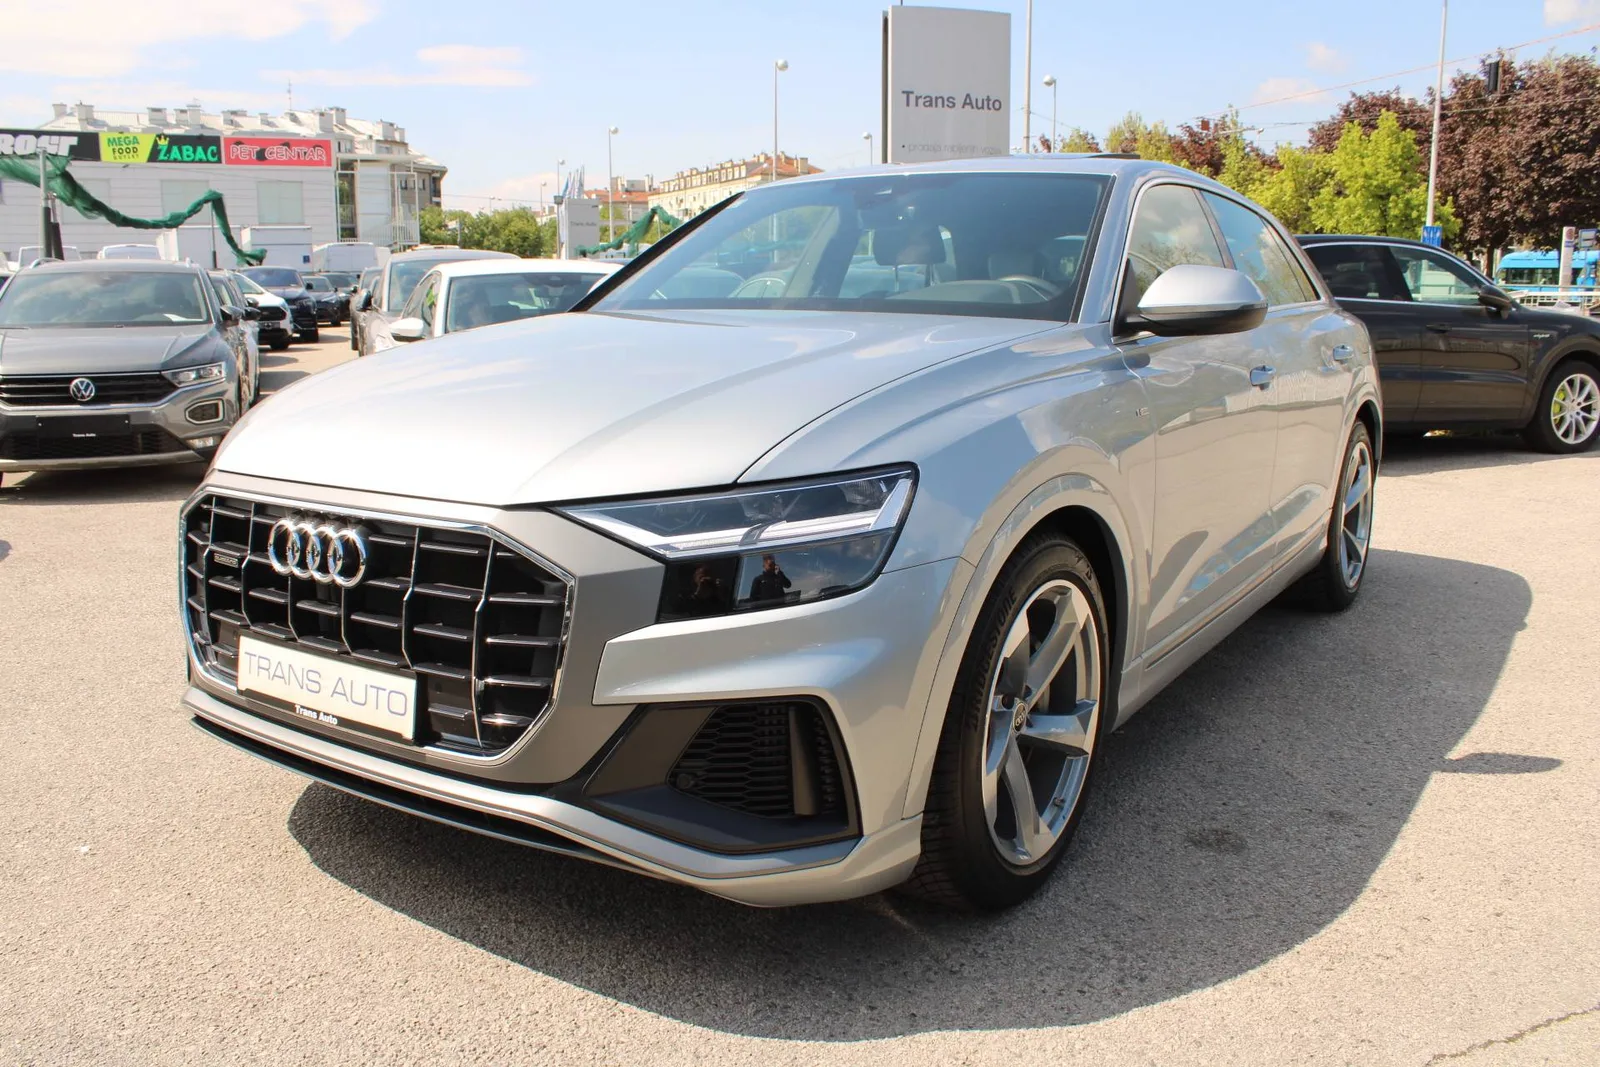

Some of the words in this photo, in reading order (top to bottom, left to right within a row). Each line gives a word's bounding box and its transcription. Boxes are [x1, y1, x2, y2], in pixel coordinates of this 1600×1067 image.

[902, 90, 956, 109] Trans
[961, 93, 1002, 111] Auto
[107, 136, 140, 147] MEGA
[112, 146, 139, 155] FOOD
[230, 144, 259, 160] PET
[265, 146, 326, 161] CENTAR
[244, 651, 322, 695] TRANS
[330, 677, 408, 717] AUTO
[295, 704, 318, 721] Trans
[318, 712, 338, 726] Auto
